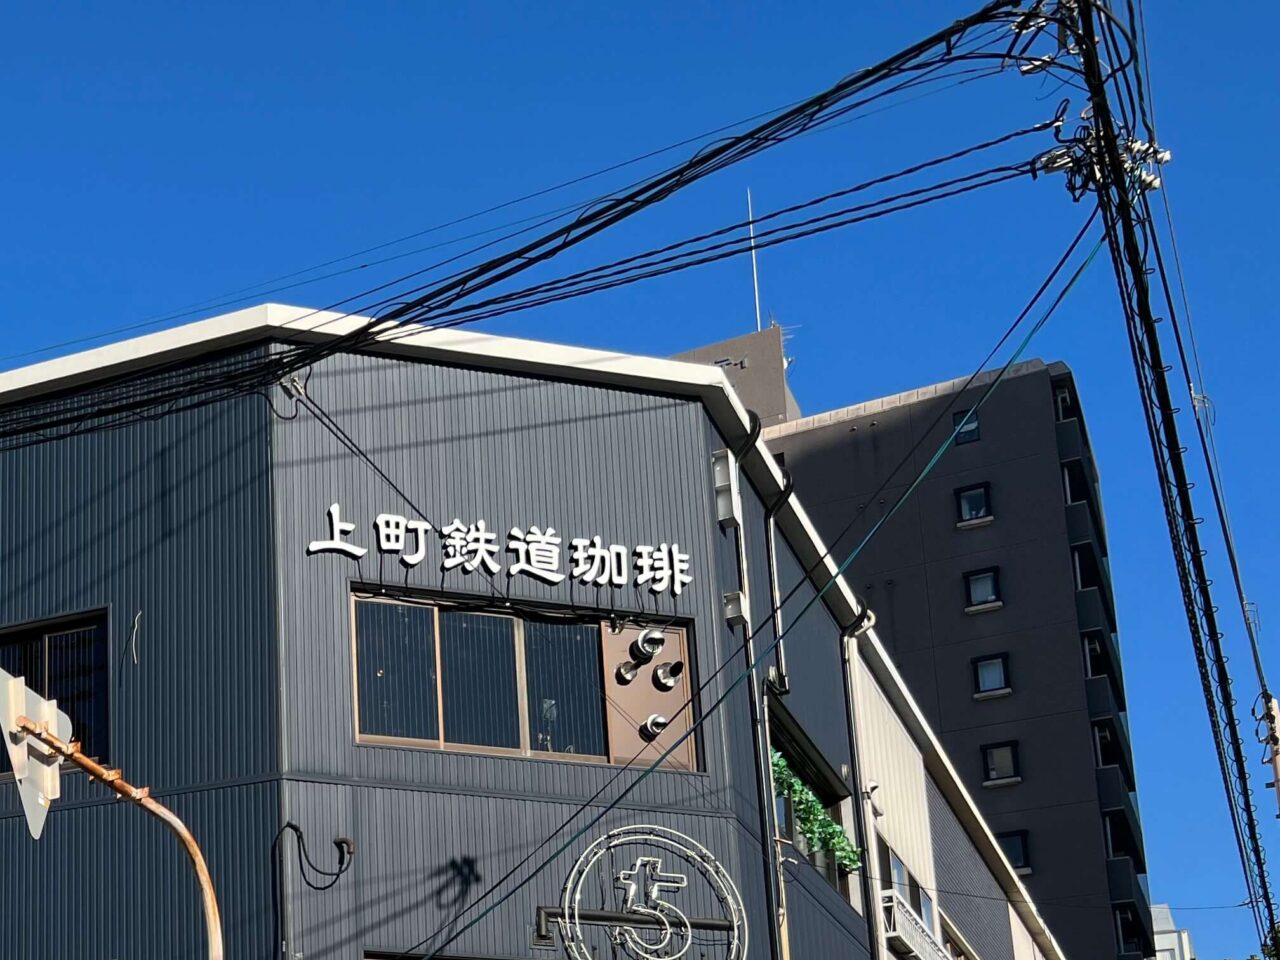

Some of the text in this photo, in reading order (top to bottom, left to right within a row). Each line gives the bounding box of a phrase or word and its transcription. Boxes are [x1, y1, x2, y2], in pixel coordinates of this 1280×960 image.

[308, 503, 693, 595] 上町鉄道珈琲
